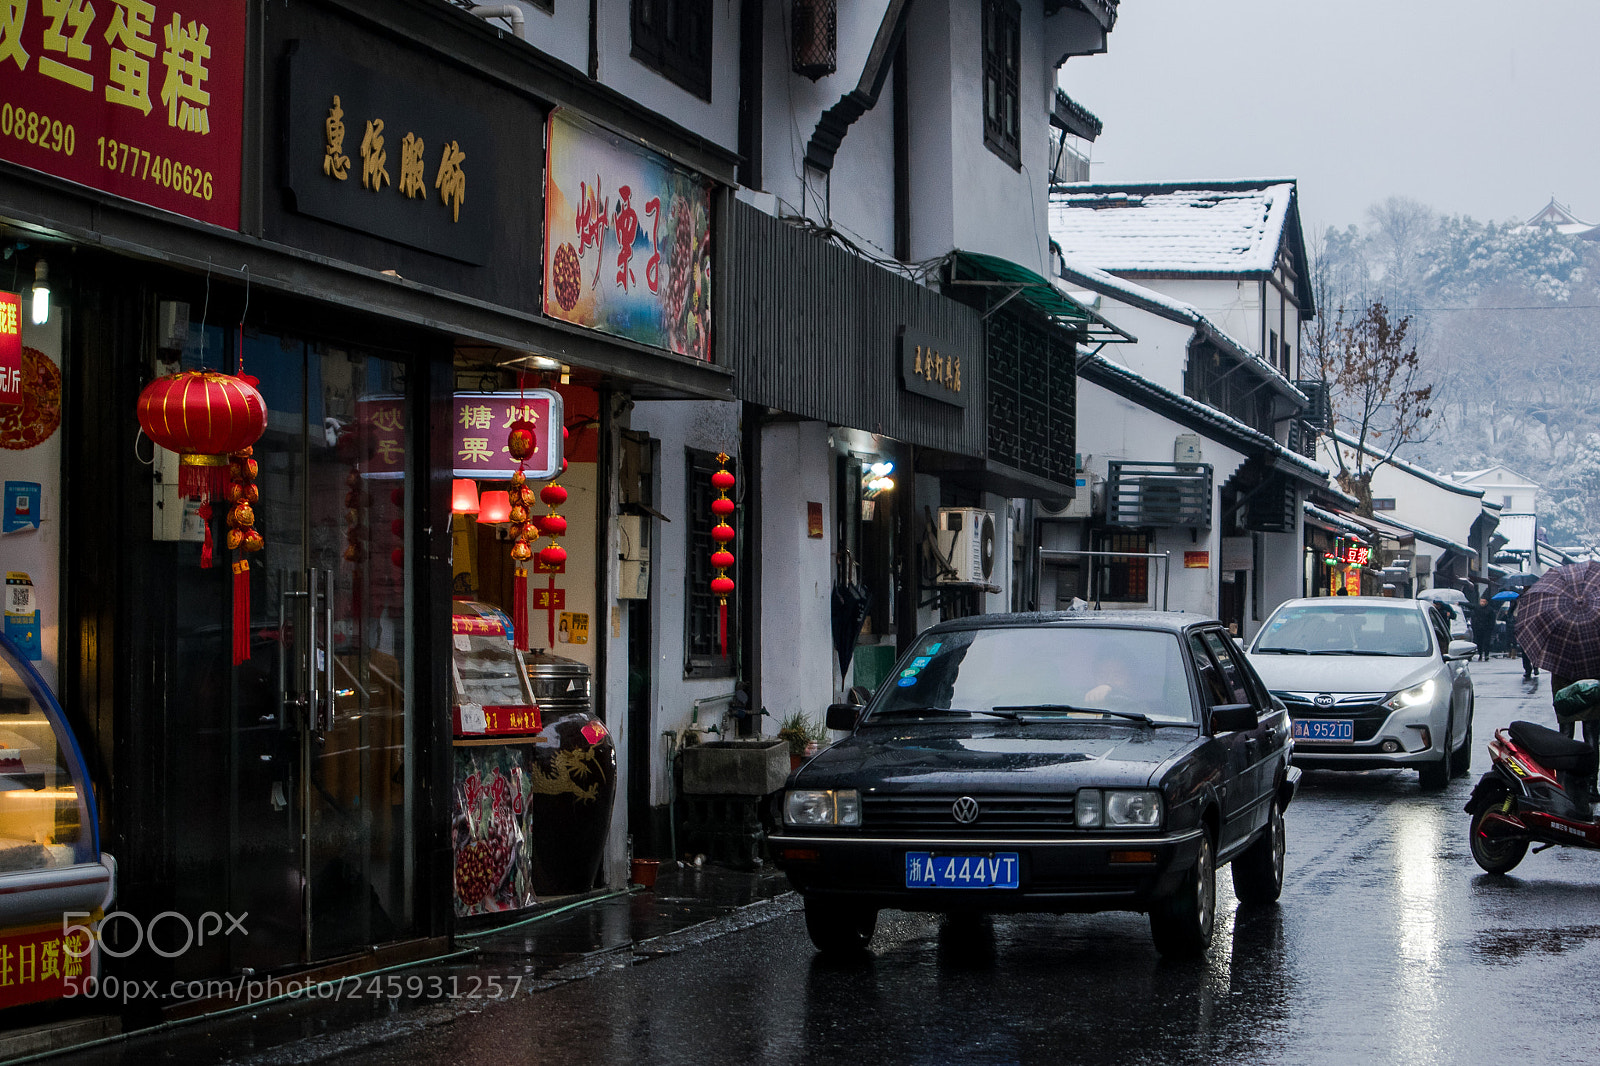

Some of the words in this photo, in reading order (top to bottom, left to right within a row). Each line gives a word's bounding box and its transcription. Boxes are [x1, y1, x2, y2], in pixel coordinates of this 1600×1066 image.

[2, 103, 75, 156] 088290
[98, 136, 212, 200] 13777406626
[576, 174, 660, 292] 炒栗子
[1347, 547, 1369, 565] 豆浆
